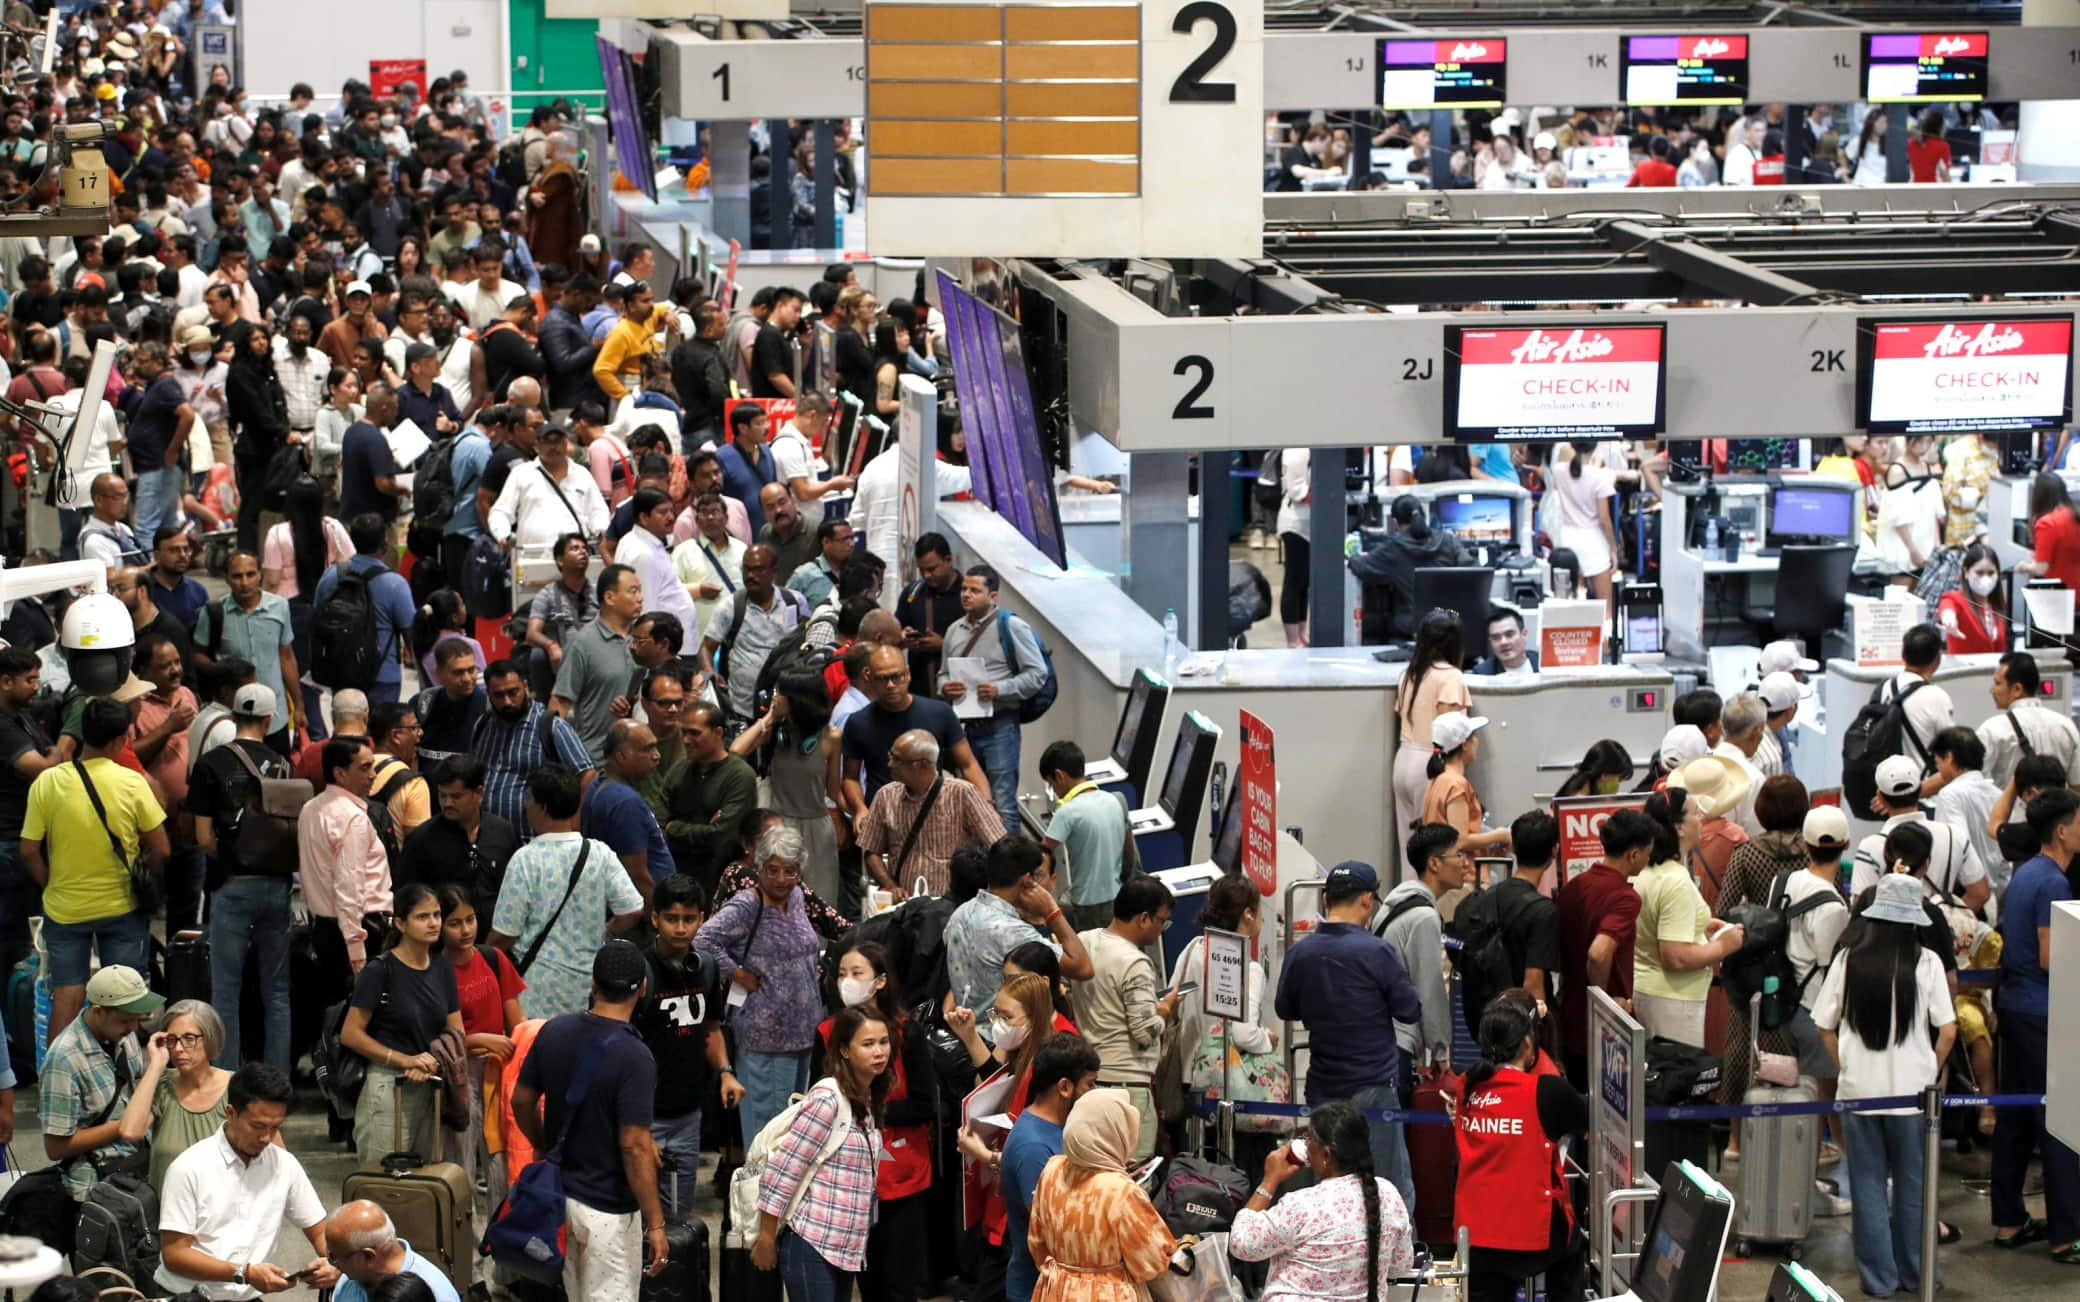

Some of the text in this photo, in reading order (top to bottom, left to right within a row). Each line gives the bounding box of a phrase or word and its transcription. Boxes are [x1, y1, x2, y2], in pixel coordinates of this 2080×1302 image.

[1168, 1, 1237, 103] 2
[1587, 55, 1608, 68] 1K
[1832, 54, 1851, 68] 1L
[1345, 58, 1364, 72] 1J
[712, 63, 730, 102] 1
[79, 176, 97, 189] 17
[1402, 357, 1433, 381] 2J
[1810, 349, 1847, 373] 2K
[1171, 354, 1215, 420] 2
[1522, 378, 1632, 396] CHECK-IN
[1934, 371, 2041, 389] CHECK-IN
[1550, 631, 1593, 640] COUNTER
[1248, 781, 1255, 801] IS
[1255, 784, 1273, 814] YOUR
[1250, 804, 1271, 834] CABIN
[1249, 827, 1273, 860] BAG FIT
[1249, 850, 1260, 873] TO
[1460, 1115, 1524, 1135] RAINEE
